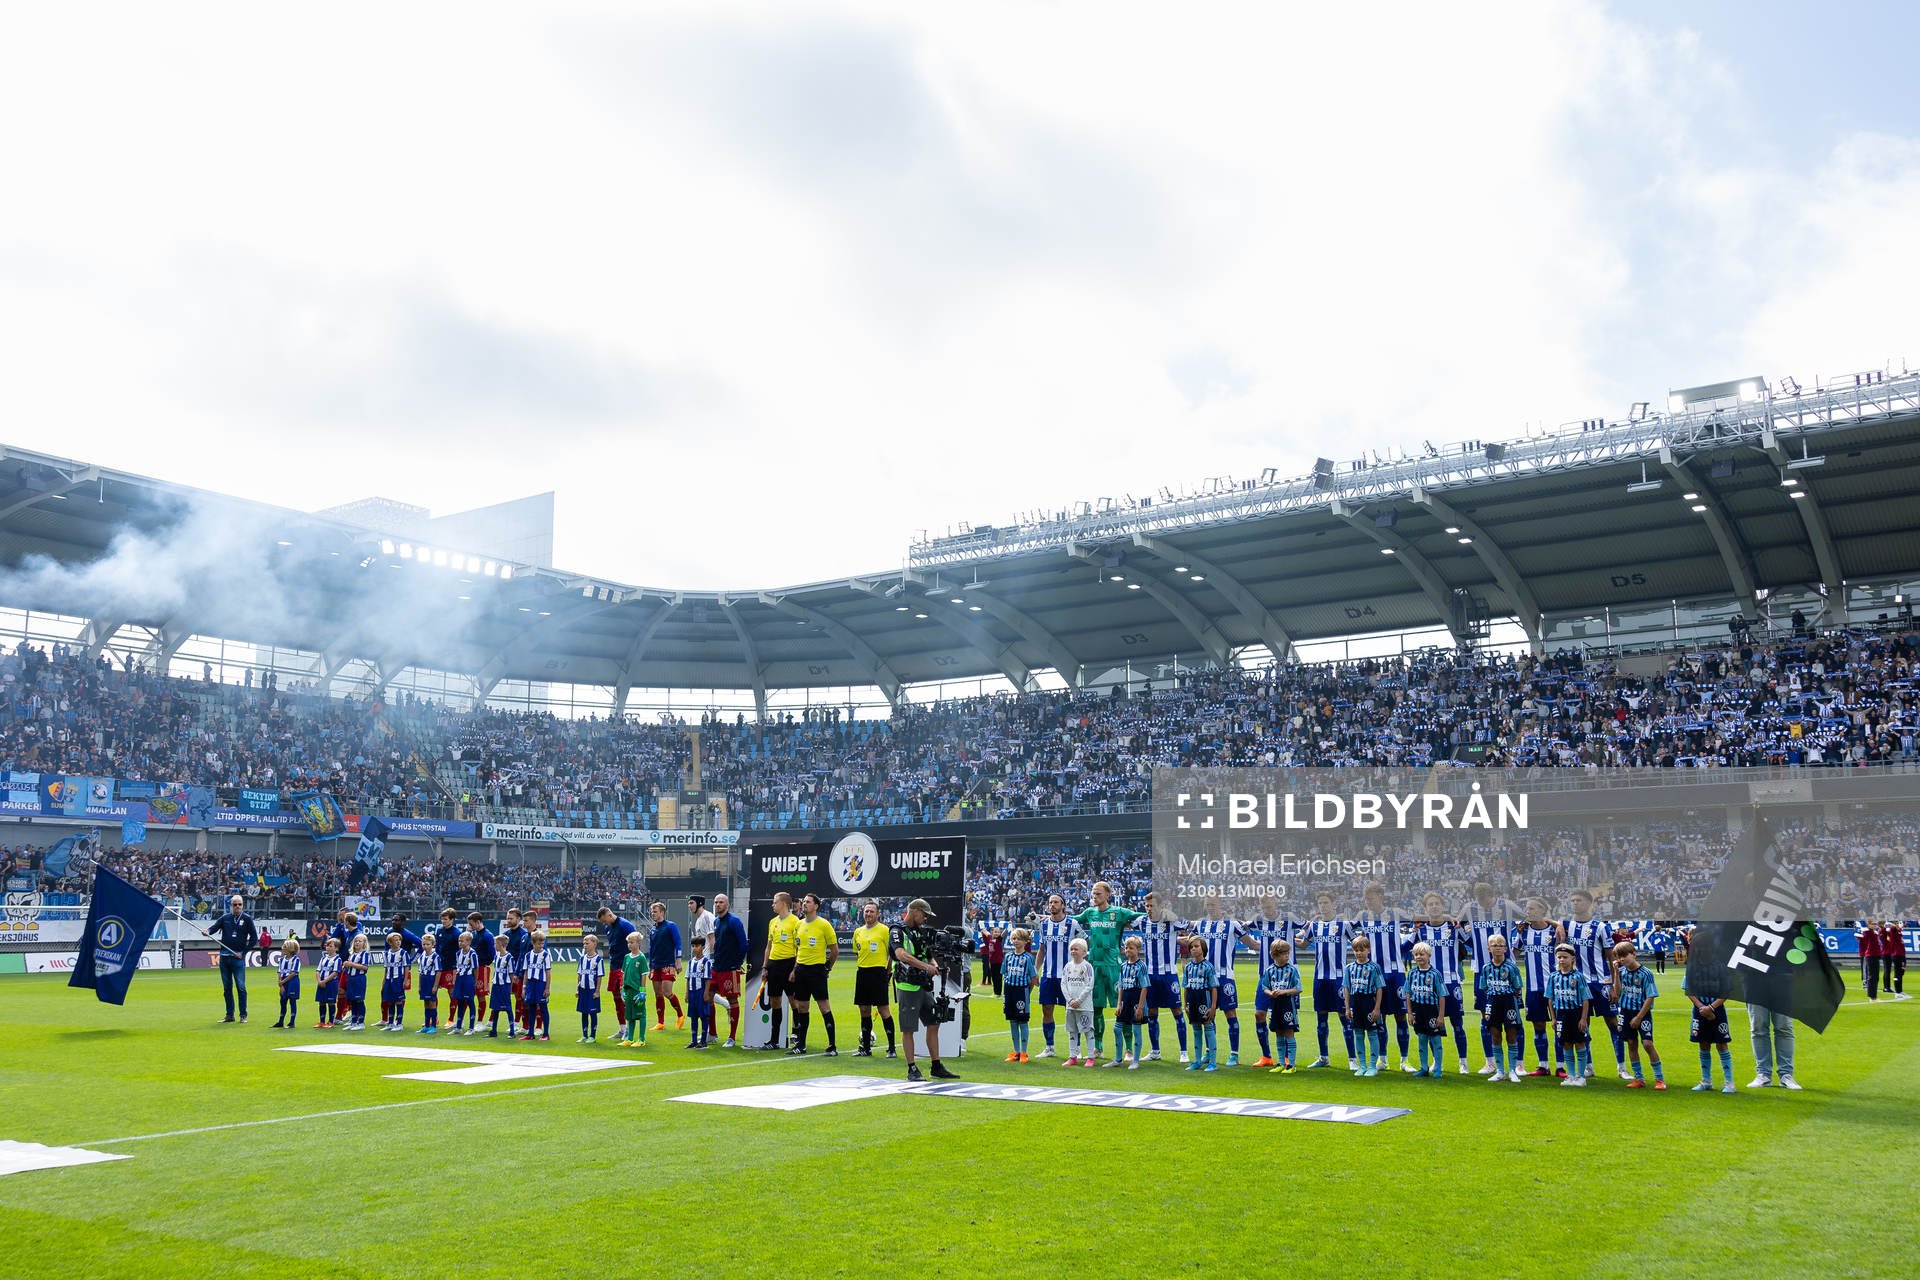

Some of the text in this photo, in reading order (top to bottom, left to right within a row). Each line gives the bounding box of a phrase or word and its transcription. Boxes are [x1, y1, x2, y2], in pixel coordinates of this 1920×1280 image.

[1611, 574, 1646, 587] D5
[1344, 605, 1376, 618] D4
[1120, 633, 1149, 644] D3
[242, 790, 278, 801] SEKTION
[412, 823, 446, 832] NORDSTAN
[496, 827, 557, 840] merinfo.se
[663, 832, 737, 844] merinfo.se
[761, 855, 818, 873] UNIBET
[890, 850, 952, 870] UNIBET
[1473, 920, 1506, 929] SERNEKE
